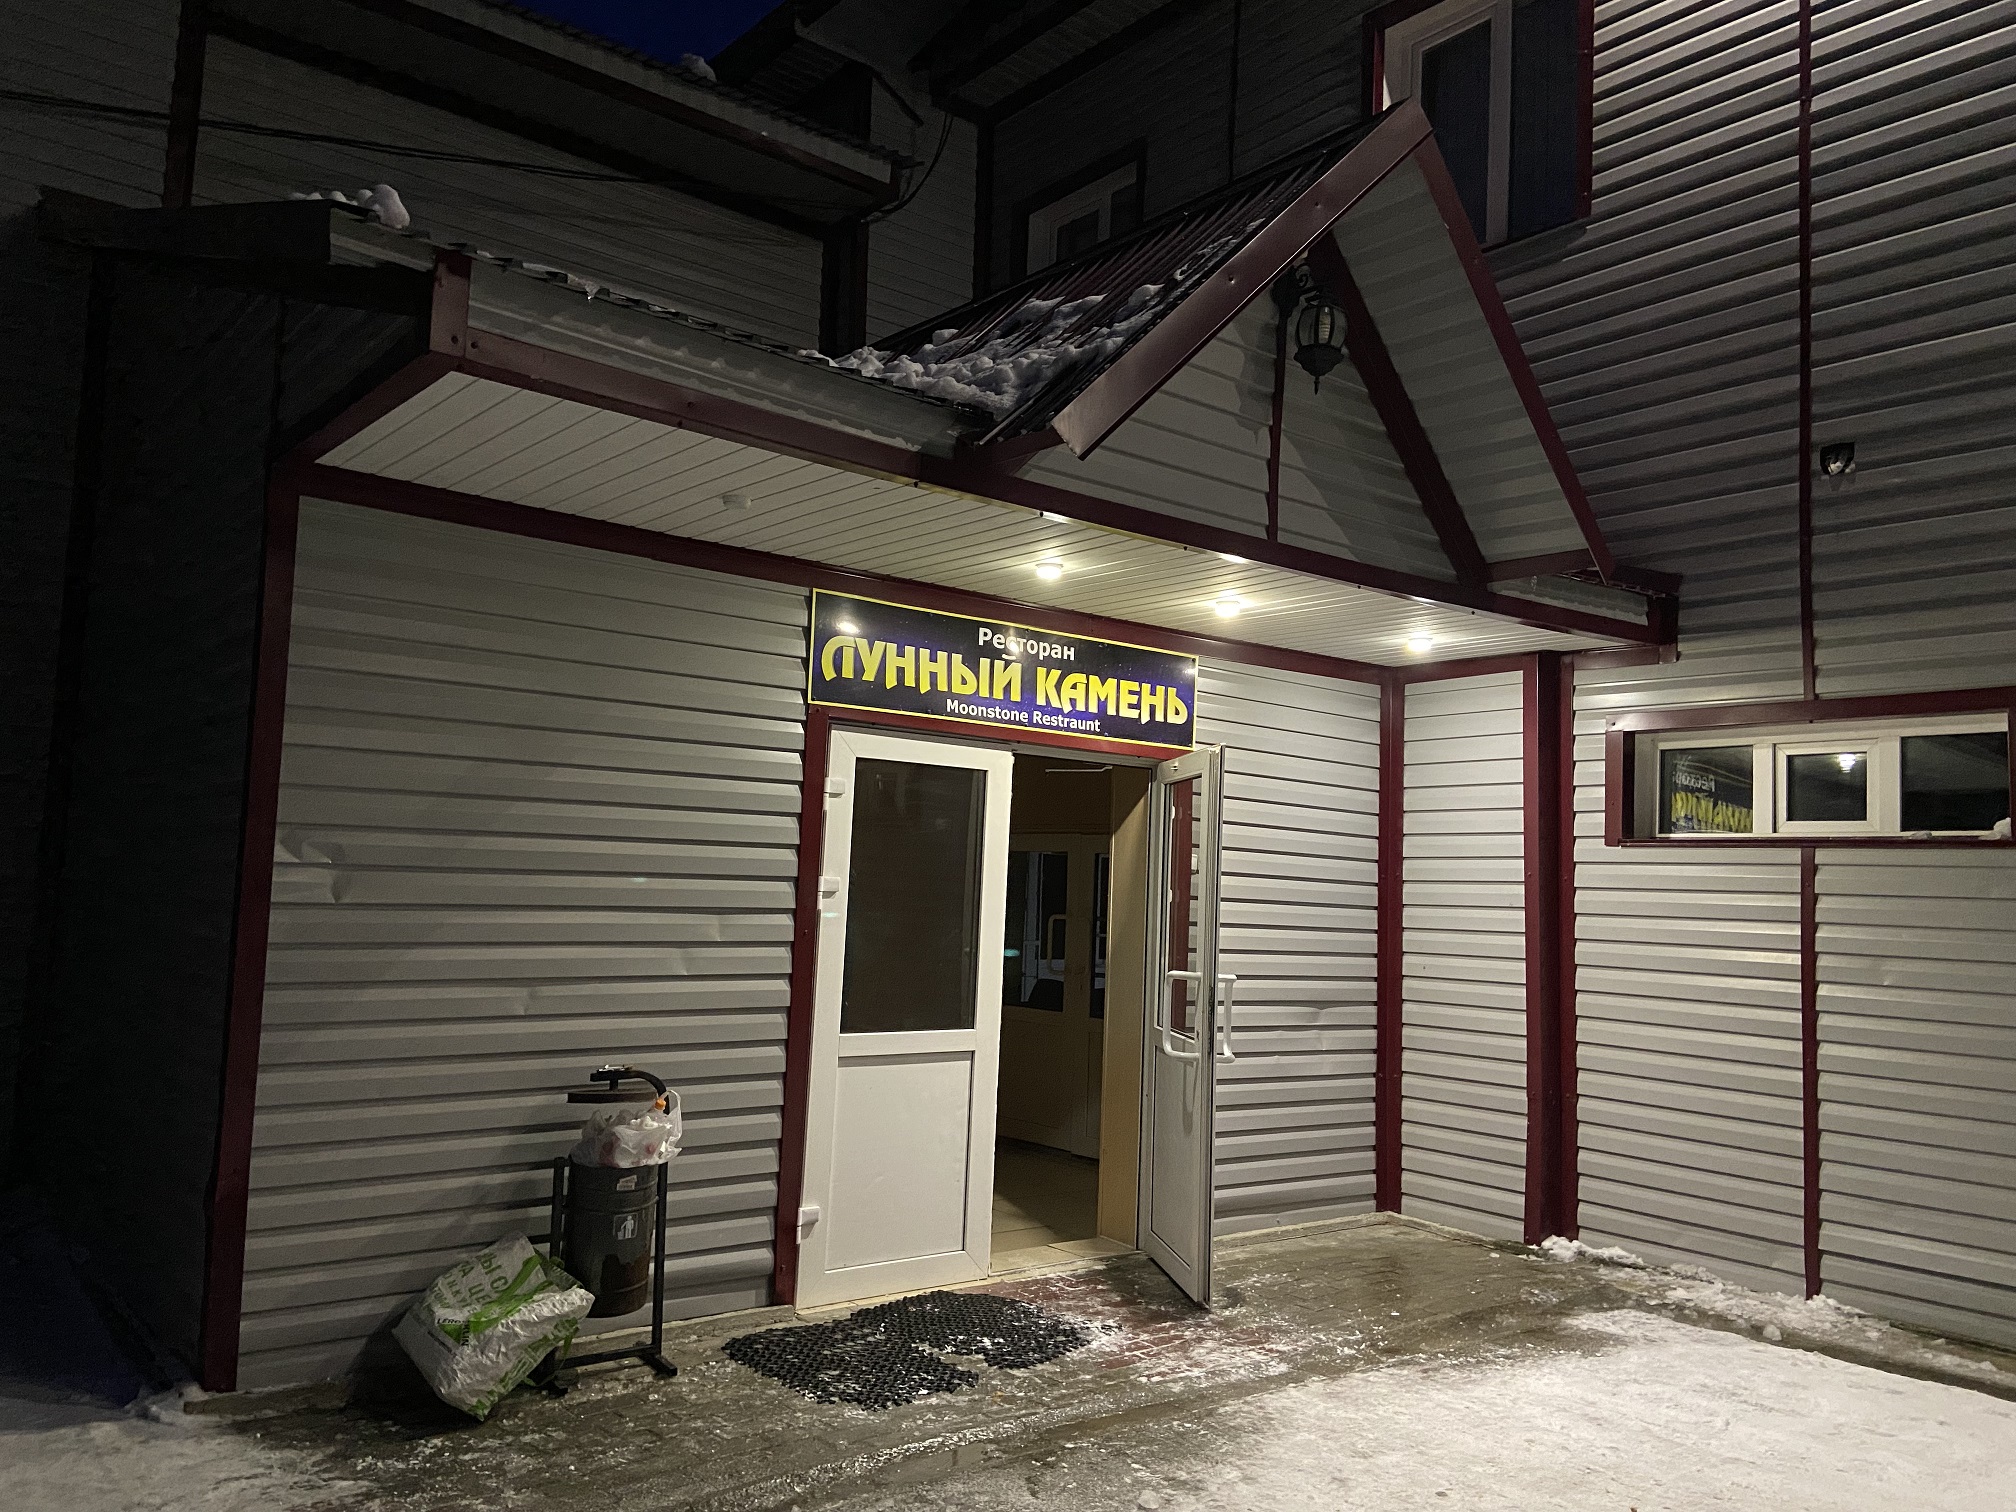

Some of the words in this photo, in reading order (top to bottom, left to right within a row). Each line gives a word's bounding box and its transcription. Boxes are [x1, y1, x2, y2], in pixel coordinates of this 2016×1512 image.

[978, 627, 1075, 661] Ресторан
[821, 634, 1023, 702] ЛУННЫЙ
[1036, 666, 1188, 725] КАМЕНЬ
[946, 698, 1029, 722] Moonstone
[1033, 710, 1101, 732] Restraunt
